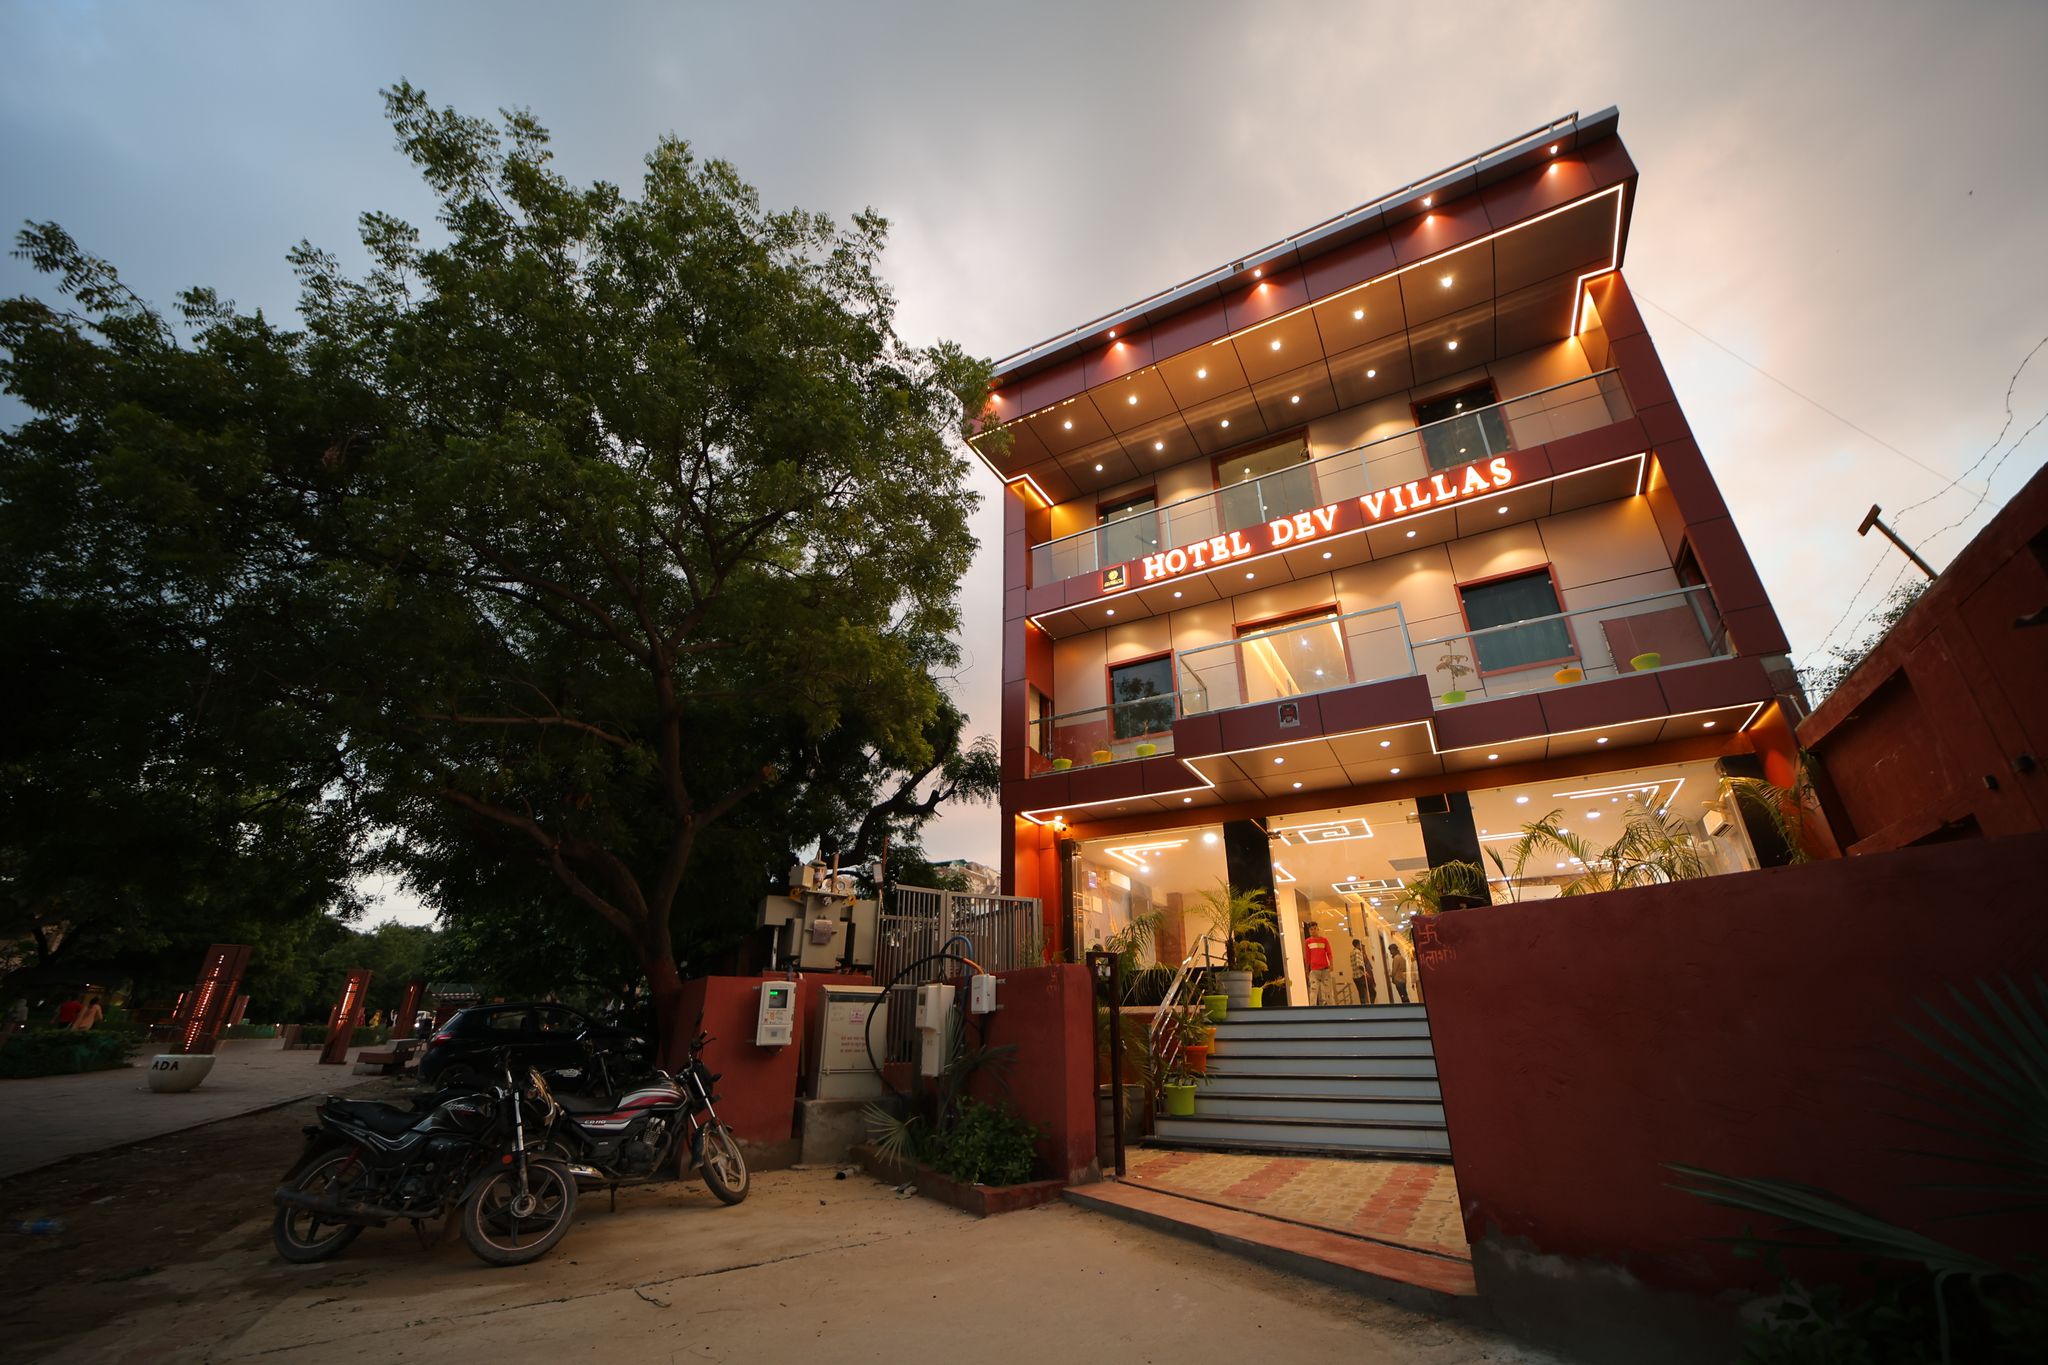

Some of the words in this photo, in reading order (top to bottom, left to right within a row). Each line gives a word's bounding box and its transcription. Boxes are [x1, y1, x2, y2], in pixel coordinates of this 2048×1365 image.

[1142, 531, 1251, 580] HOTEL
[1269, 504, 1338, 546] DEV
[1359, 457, 1512, 519] VILLAS
[151, 1060, 179, 1071] ADA
